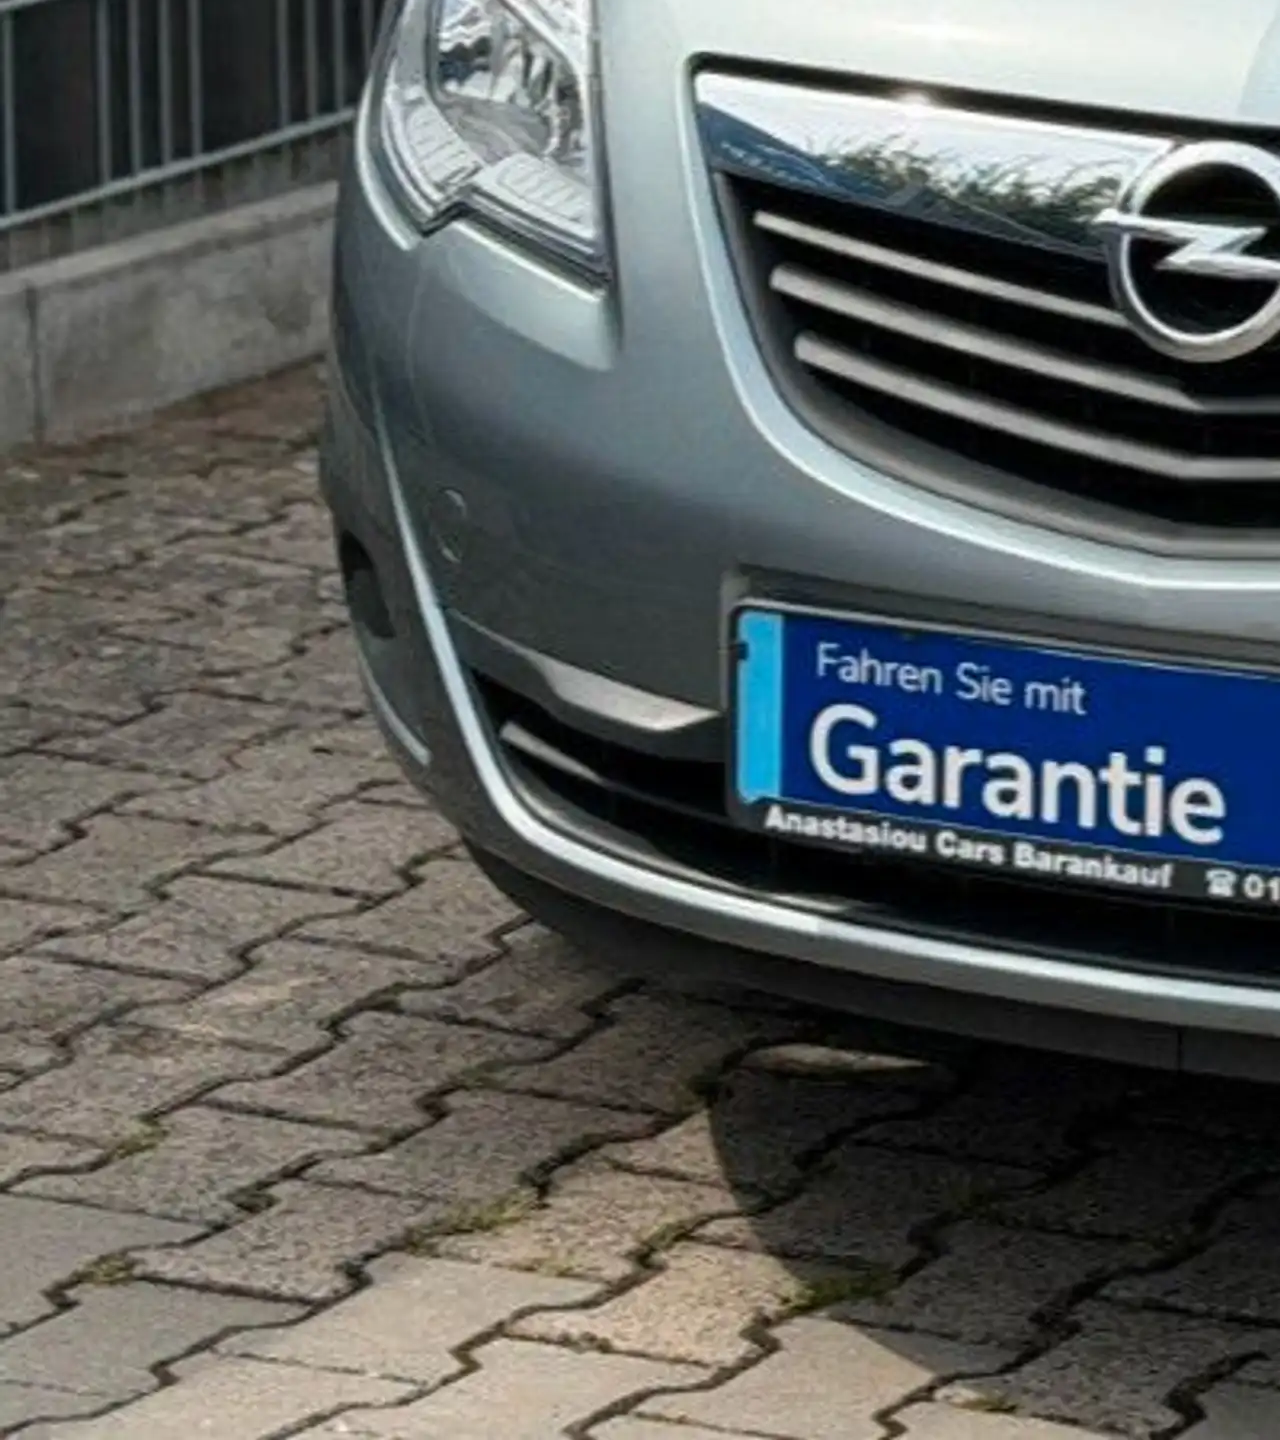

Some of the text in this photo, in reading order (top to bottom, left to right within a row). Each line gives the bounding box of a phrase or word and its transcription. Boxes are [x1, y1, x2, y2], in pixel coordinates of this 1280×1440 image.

[817, 642, 1087, 715] Fahren Sie mit
[809, 703, 1226, 845] Garantie
[763, 805, 1177, 889] Anastasiou Cars Barankauf
